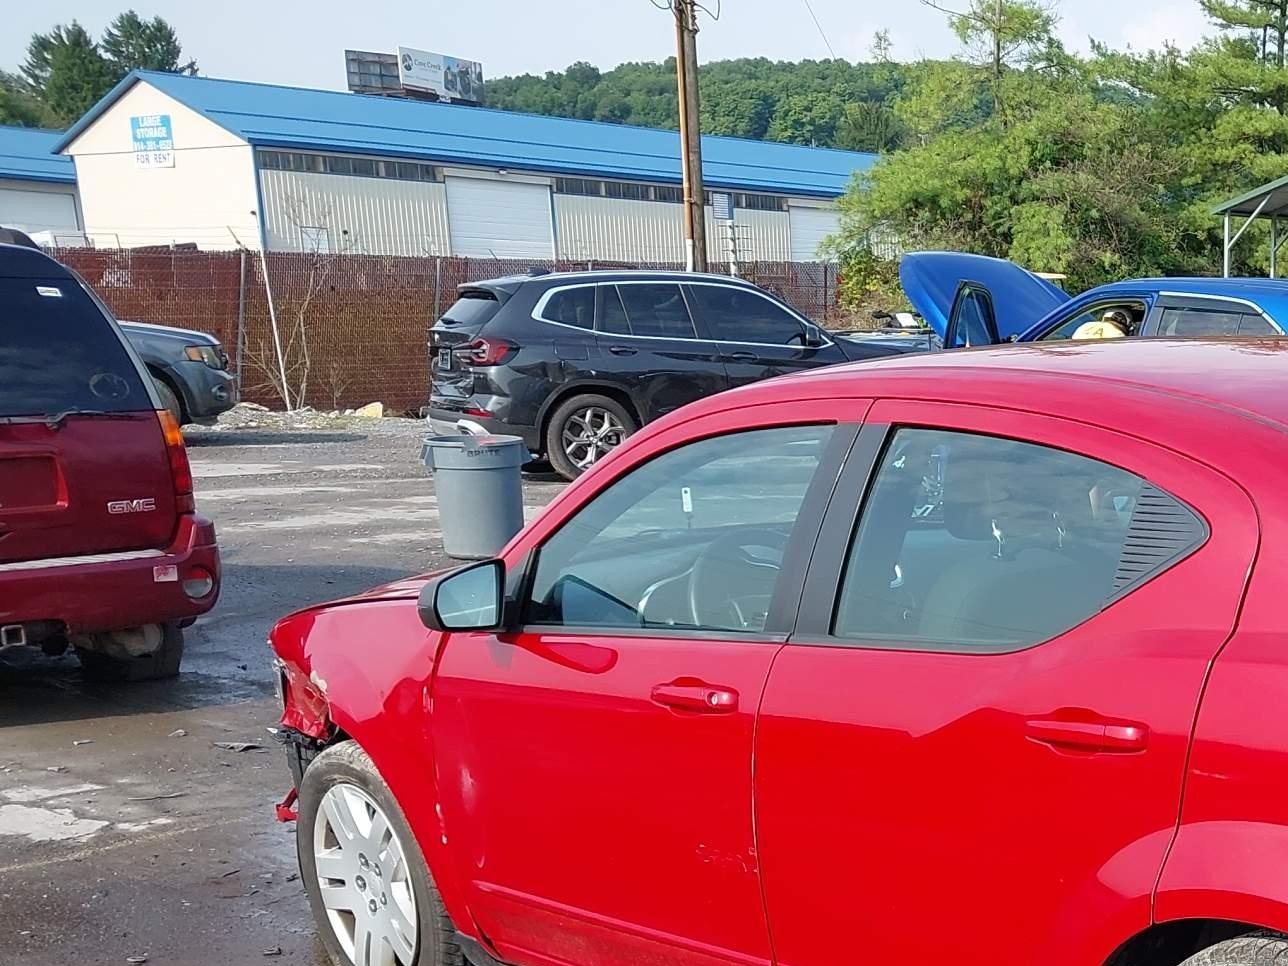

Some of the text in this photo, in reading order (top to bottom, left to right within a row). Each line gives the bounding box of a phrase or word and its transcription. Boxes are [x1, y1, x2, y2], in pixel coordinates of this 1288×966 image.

[138, 115, 162, 127] LARGE
[136, 126, 168, 139] STORAGE
[136, 152, 171, 164] FOR RENT
[107, 498, 156, 514] GMC
